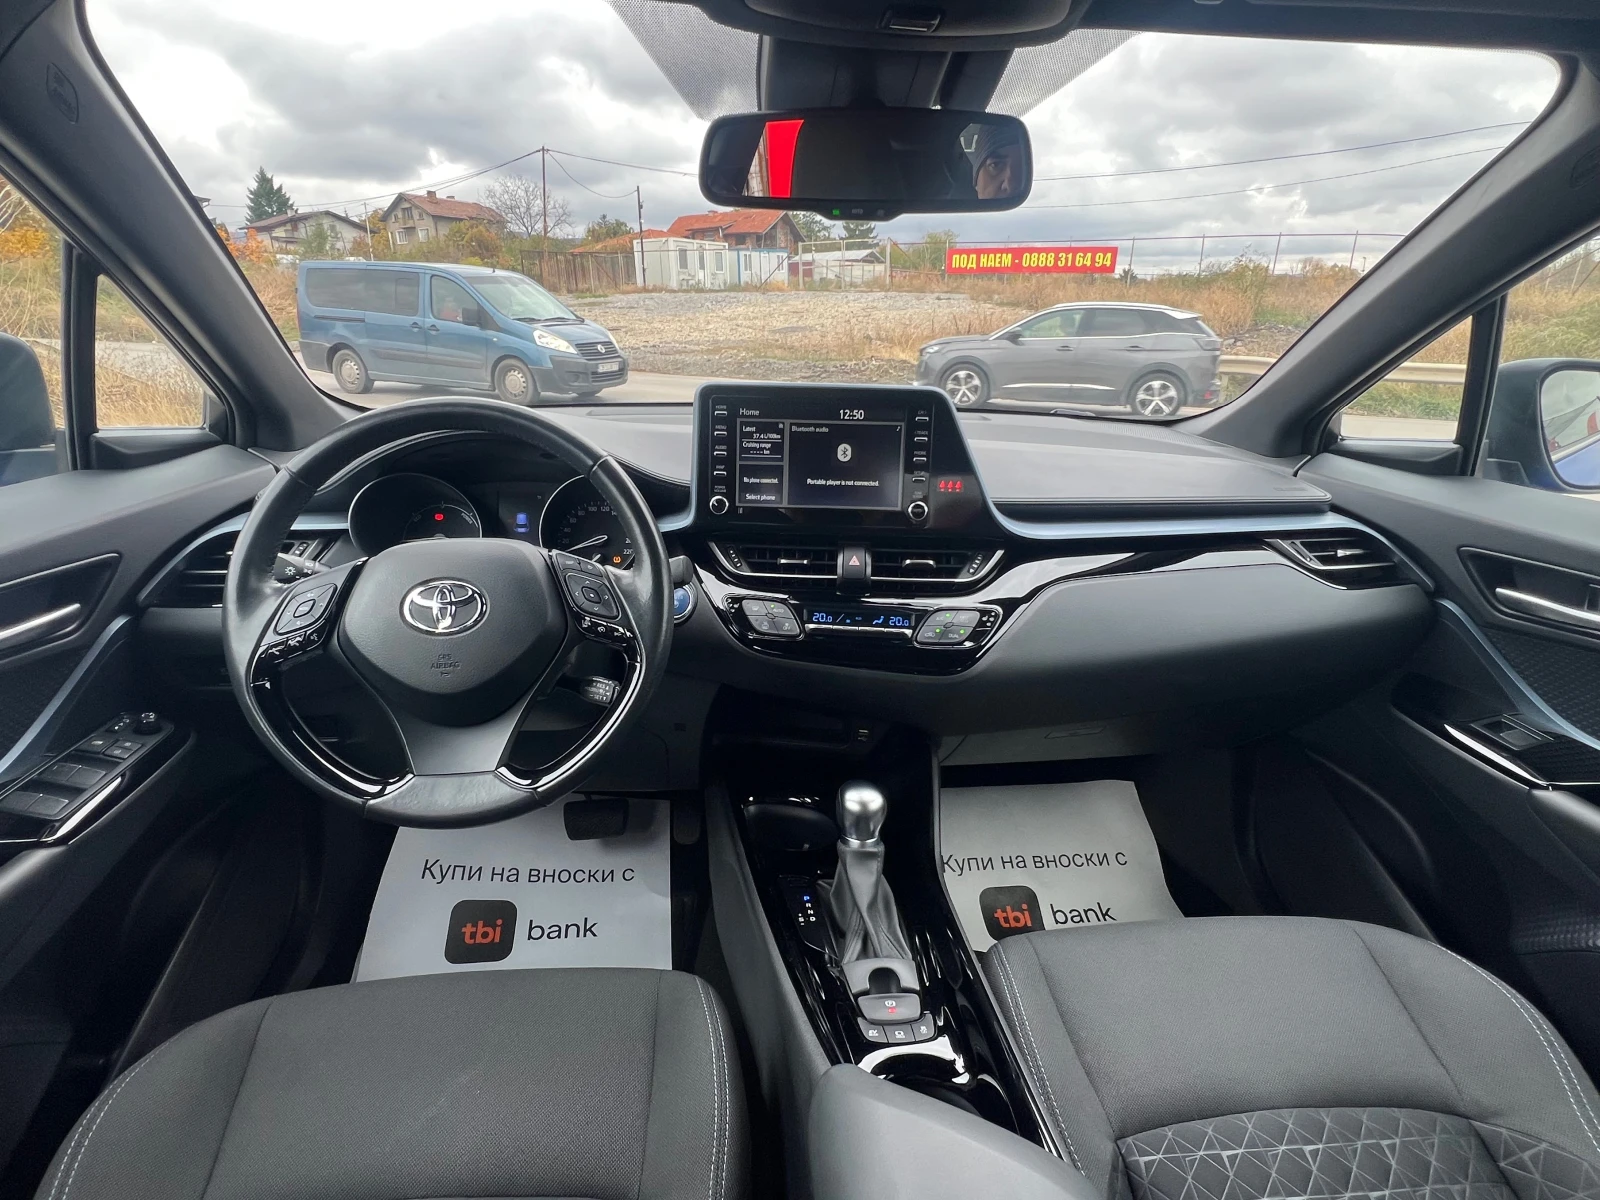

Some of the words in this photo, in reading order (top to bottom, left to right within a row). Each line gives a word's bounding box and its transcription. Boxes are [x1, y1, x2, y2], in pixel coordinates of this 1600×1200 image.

[951, 254, 977, 270] ПОД
[979, 253, 1012, 268] НАЕМ
[1021, 252, 1055, 268] 0888
[1057, 252, 1073, 267] 31
[1075, 252, 1092, 267] 64
[1094, 252, 1113, 267] 94
[739, 407, 760, 416] Home
[839, 409, 865, 420] 12:50
[742, 441, 760, 449] Cruising
[812, 612, 833, 623] 20.0
[888, 616, 910, 627] 20.0
[431, 661, 460, 669] AIRBAG
[942, 854, 995, 876] Купи
[1000, 854, 1028, 870] на
[1032, 850, 1110, 869] вноски
[421, 859, 483, 885] Купи
[490, 866, 520, 883] на
[527, 868, 615, 884] вноски
[992, 903, 1033, 928] tbi
[1050, 902, 1117, 925] bank
[461, 919, 503, 944] tbi
[527, 917, 598, 940] bank
